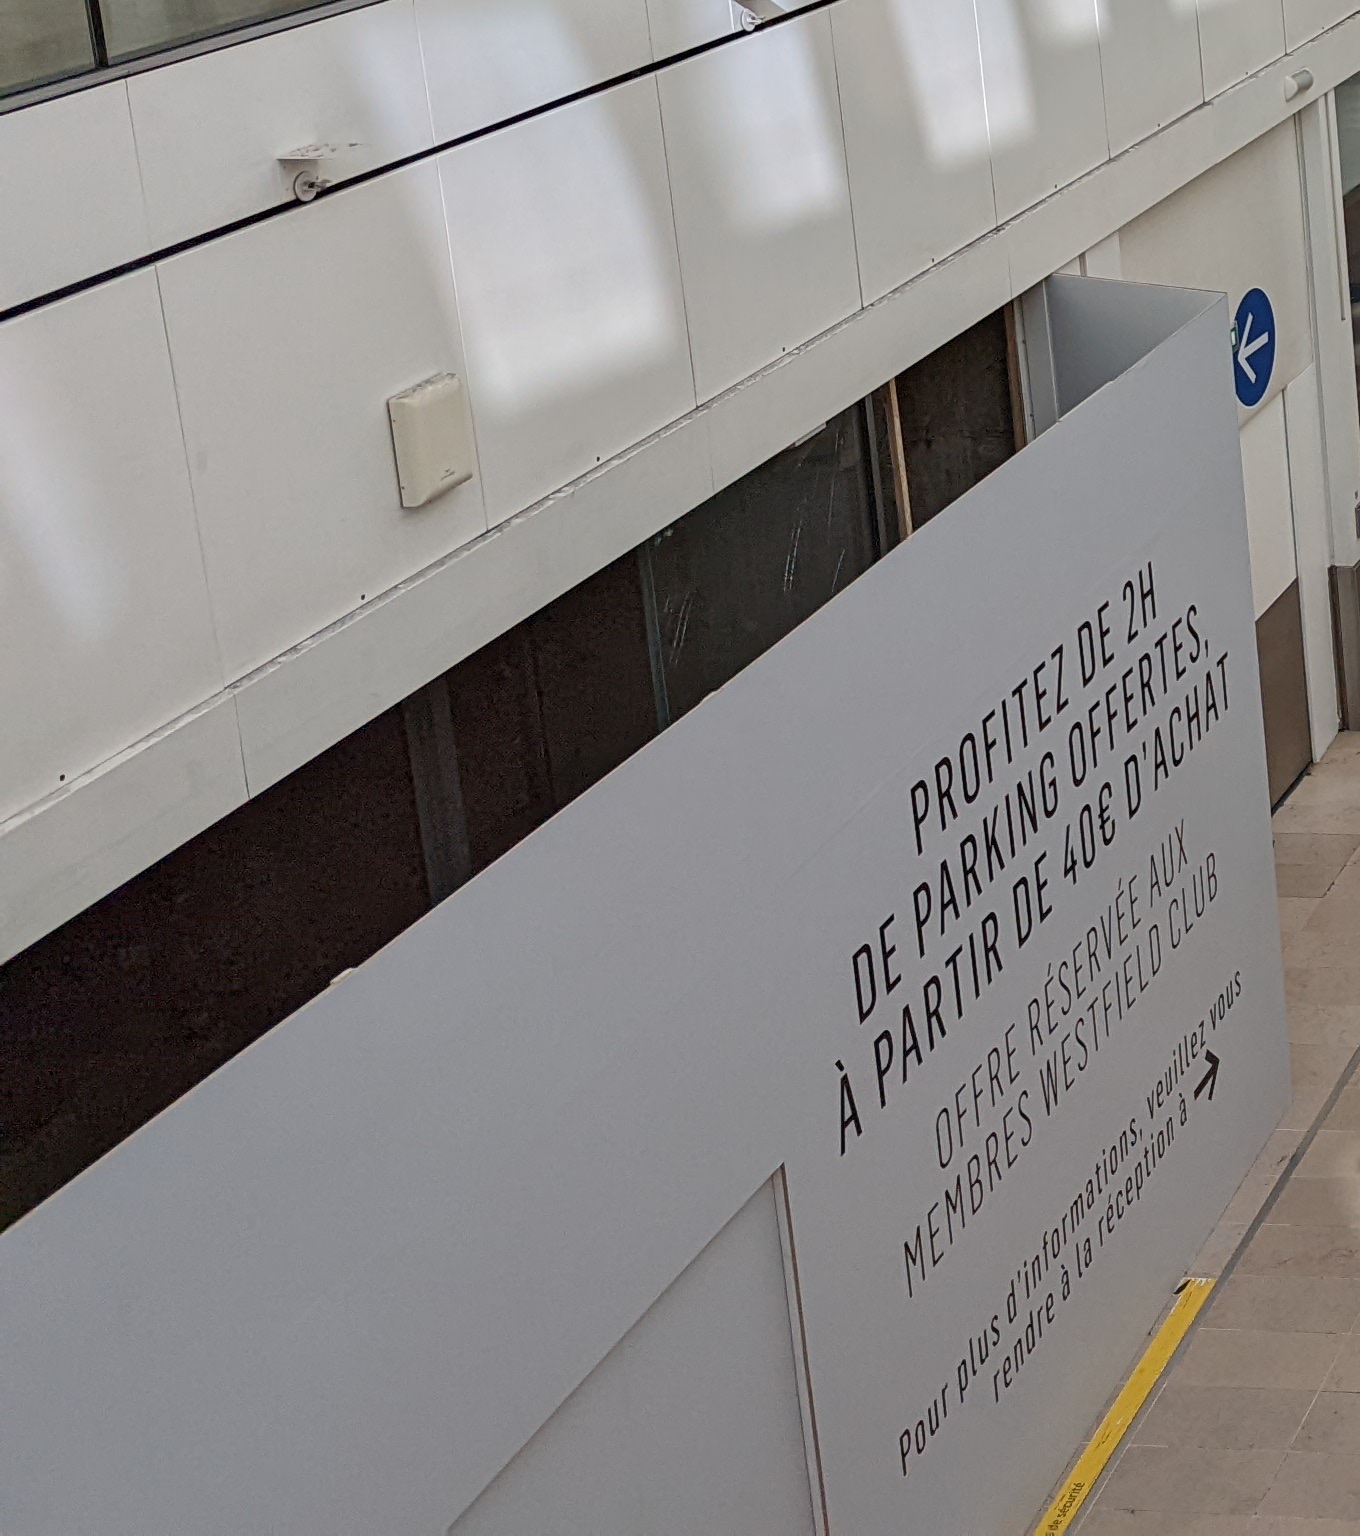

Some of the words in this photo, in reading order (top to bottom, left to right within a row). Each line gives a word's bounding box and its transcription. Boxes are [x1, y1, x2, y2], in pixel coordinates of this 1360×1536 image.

[851, 913, 903, 1026] DE
[912, 751, 1059, 959] PARKING
[1068, 604, 1210, 788] OFFERTES,
[910, 644, 1070, 857] PROFITEZ
[1077, 600, 1116, 689] DE
[1122, 561, 1157, 645] 2H
[834, 1059, 863, 1157] À
[873, 910, 1004, 1110] PARTIR
[1011, 850, 1053, 950] DE
[1063, 781, 1117, 886] 40€
[1123, 651, 1230, 821] D'ACHAT
[903, 1089, 1034, 1300] MEMBRES
[1039, 923, 1163, 1118] WESTFIELD
[1168, 851, 1219, 951] CLUB
[935, 1023, 1021, 1170] OFFRE
[1027, 874, 1143, 1057] RÉSERVÉE
[1149, 819, 1189, 909] AUX
[899, 1382, 950, 1478] Pour
[957, 1314, 1001, 1404] plus
[1006, 1117, 1144, 1325] d'informations,
[1146, 1019, 1208, 1120] veuillez
[1209, 969, 1243, 1032] vous
[993, 1291, 1057, 1405] rendre
[1061, 1264, 1072, 1302] à
[1077, 1236, 1094, 1279] la
[1098, 1116, 1176, 1249] réception
[1178, 1092, 1189, 1128] à
[1047, 1514, 1062, 1531] de
[1058, 1481, 1086, 1520] sécurité
